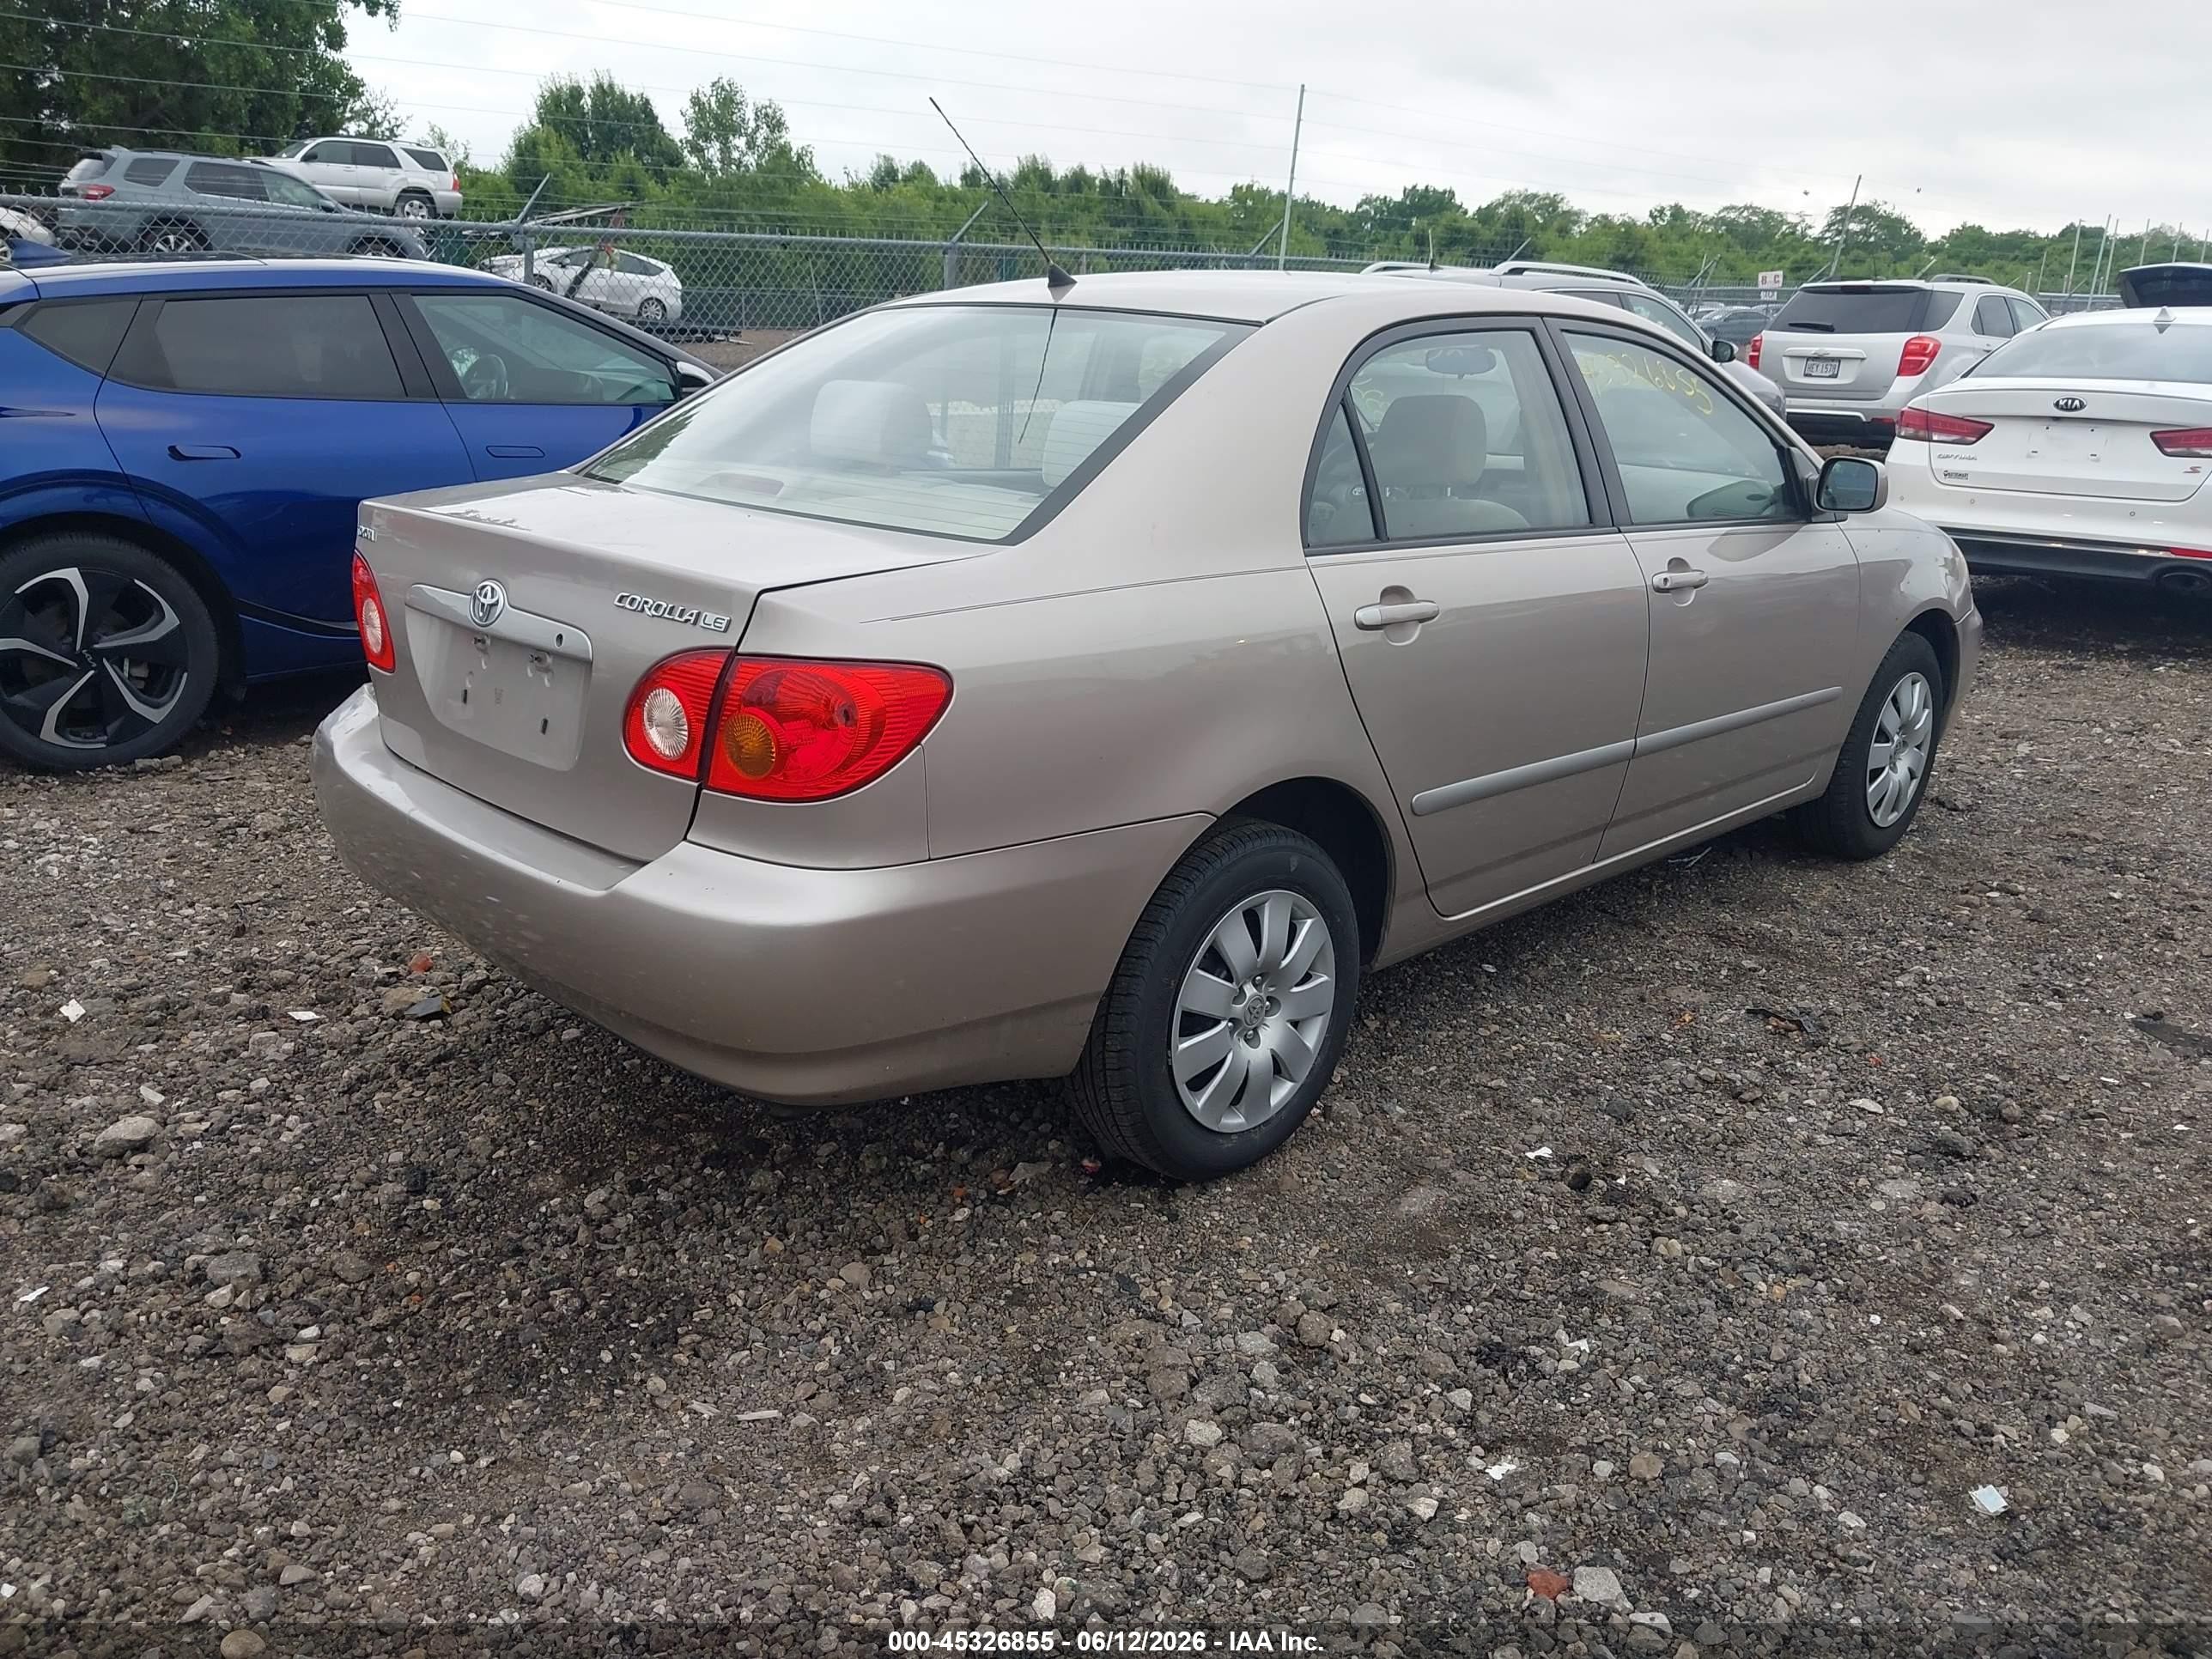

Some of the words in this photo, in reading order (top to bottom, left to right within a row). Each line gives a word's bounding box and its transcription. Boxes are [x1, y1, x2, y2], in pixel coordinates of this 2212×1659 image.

[1773, 274, 1780, 284] C
[2058, 398, 2081, 410] KIA
[2183, 465, 2202, 474] S
[613, 592, 701, 626] COROLLA
[700, 611, 731, 633] LE
